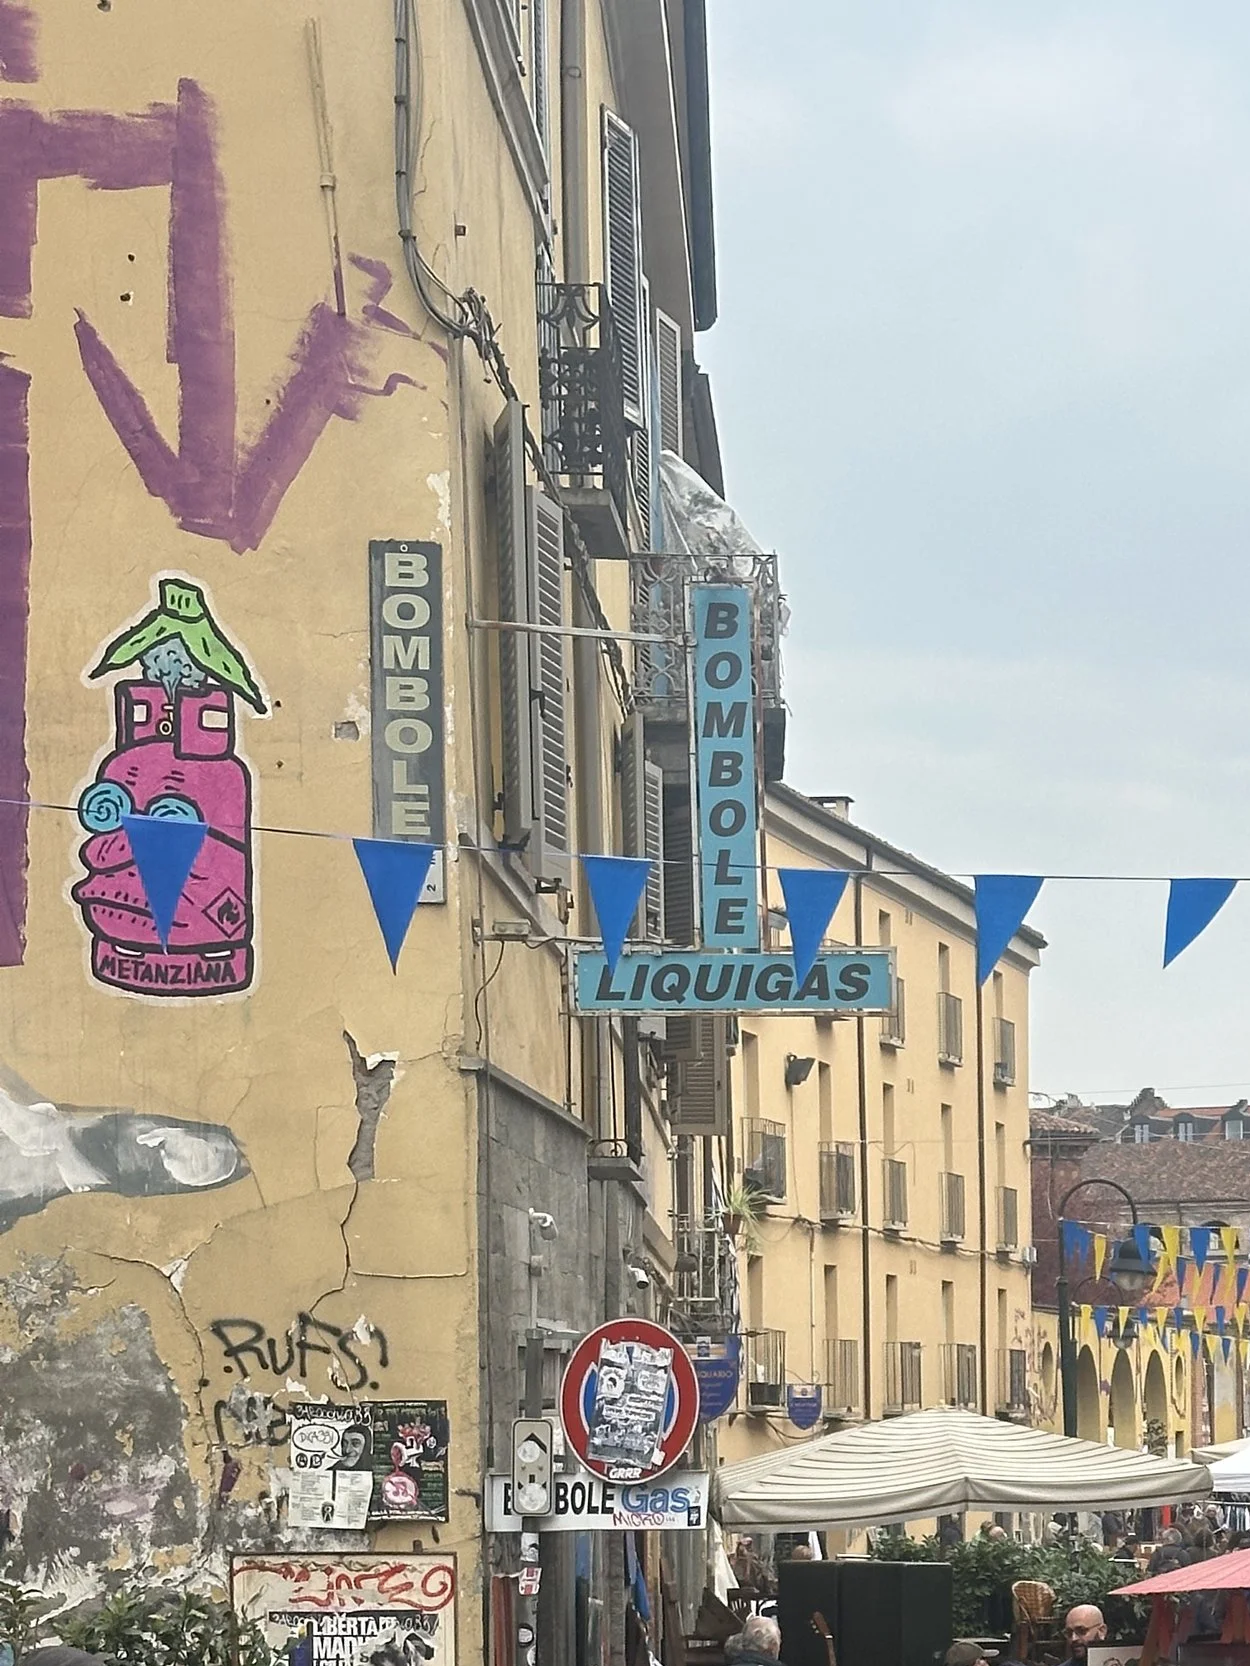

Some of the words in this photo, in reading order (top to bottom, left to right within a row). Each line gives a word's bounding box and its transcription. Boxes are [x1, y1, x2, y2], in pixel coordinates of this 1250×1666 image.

[382, 552, 433, 836] BOMBOLE
[702, 602, 748, 935] BOMBOLE
[99, 955, 237, 985] METANZIANA
[596, 961, 871, 1002] LIQUIGAS
[504, 1481, 615, 1516] BBOLE
[621, 1483, 690, 1514] Gas
